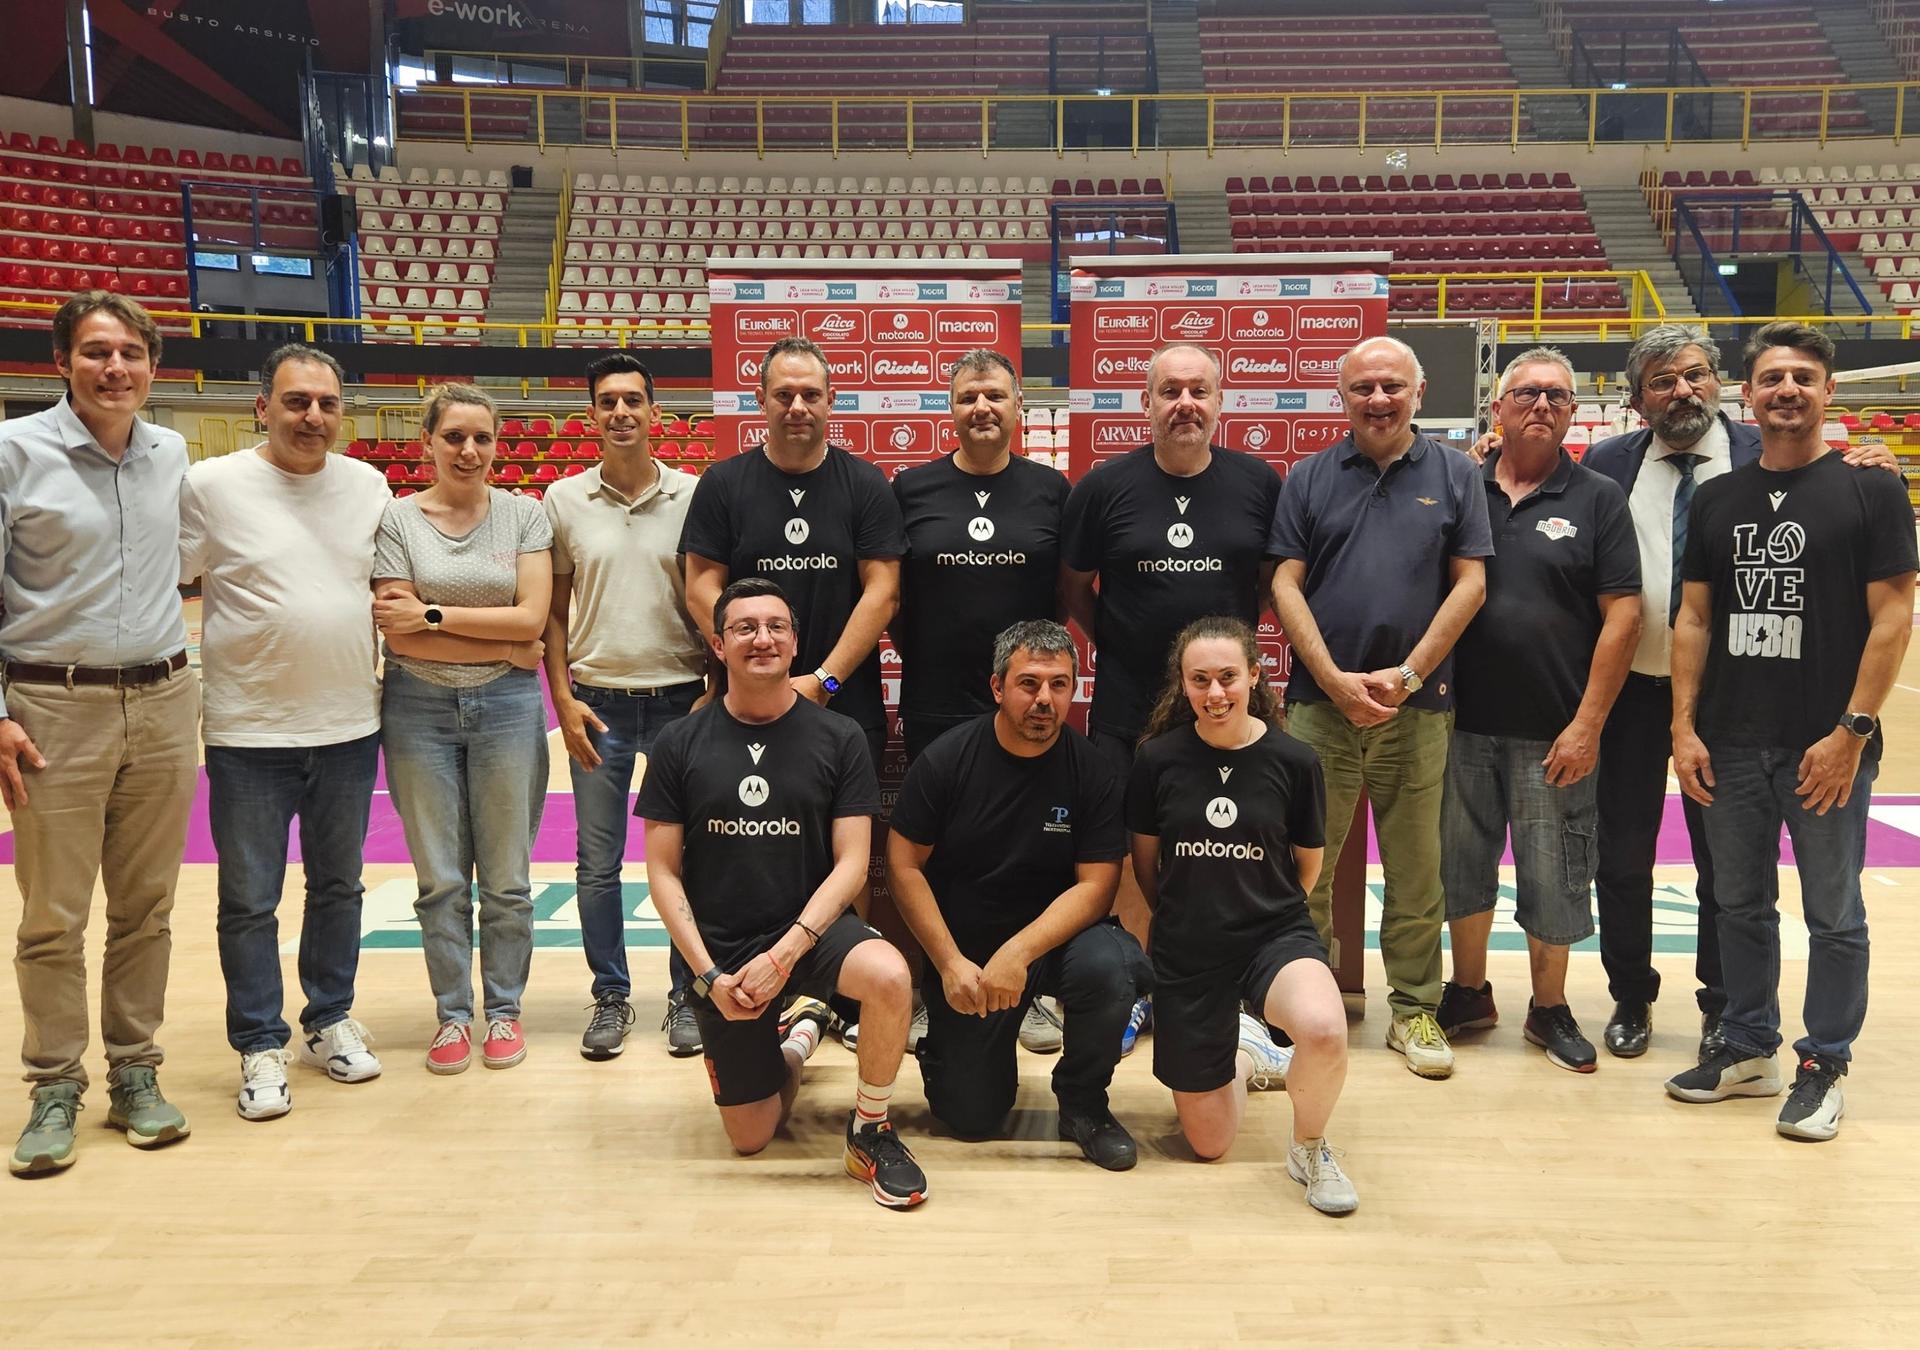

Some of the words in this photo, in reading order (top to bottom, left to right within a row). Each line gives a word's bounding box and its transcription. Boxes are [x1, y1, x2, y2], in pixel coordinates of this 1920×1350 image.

[427, 0, 523, 29] e-work
[521, 16, 591, 34] ARENA
[147, 7, 220, 28] BUSTO
[234, 23, 320, 47] ARSIZIO
[813, 313, 856, 333] Laica
[939, 321, 994, 333] macron
[1170, 310, 1215, 330] Laica
[1300, 316, 1358, 329] macron
[877, 330, 924, 340] motorola
[1236, 328, 1284, 337] motorola
[874, 360, 929, 375] Ricola
[1231, 357, 1288, 373] Ricola
[1096, 426, 1147, 441] ARVAL
[757, 553, 838, 571] motorola
[937, 549, 1026, 566] motorola
[1137, 556, 1222, 572] motorola
[708, 817, 801, 836] motorola
[1175, 838, 1265, 861] motorola
